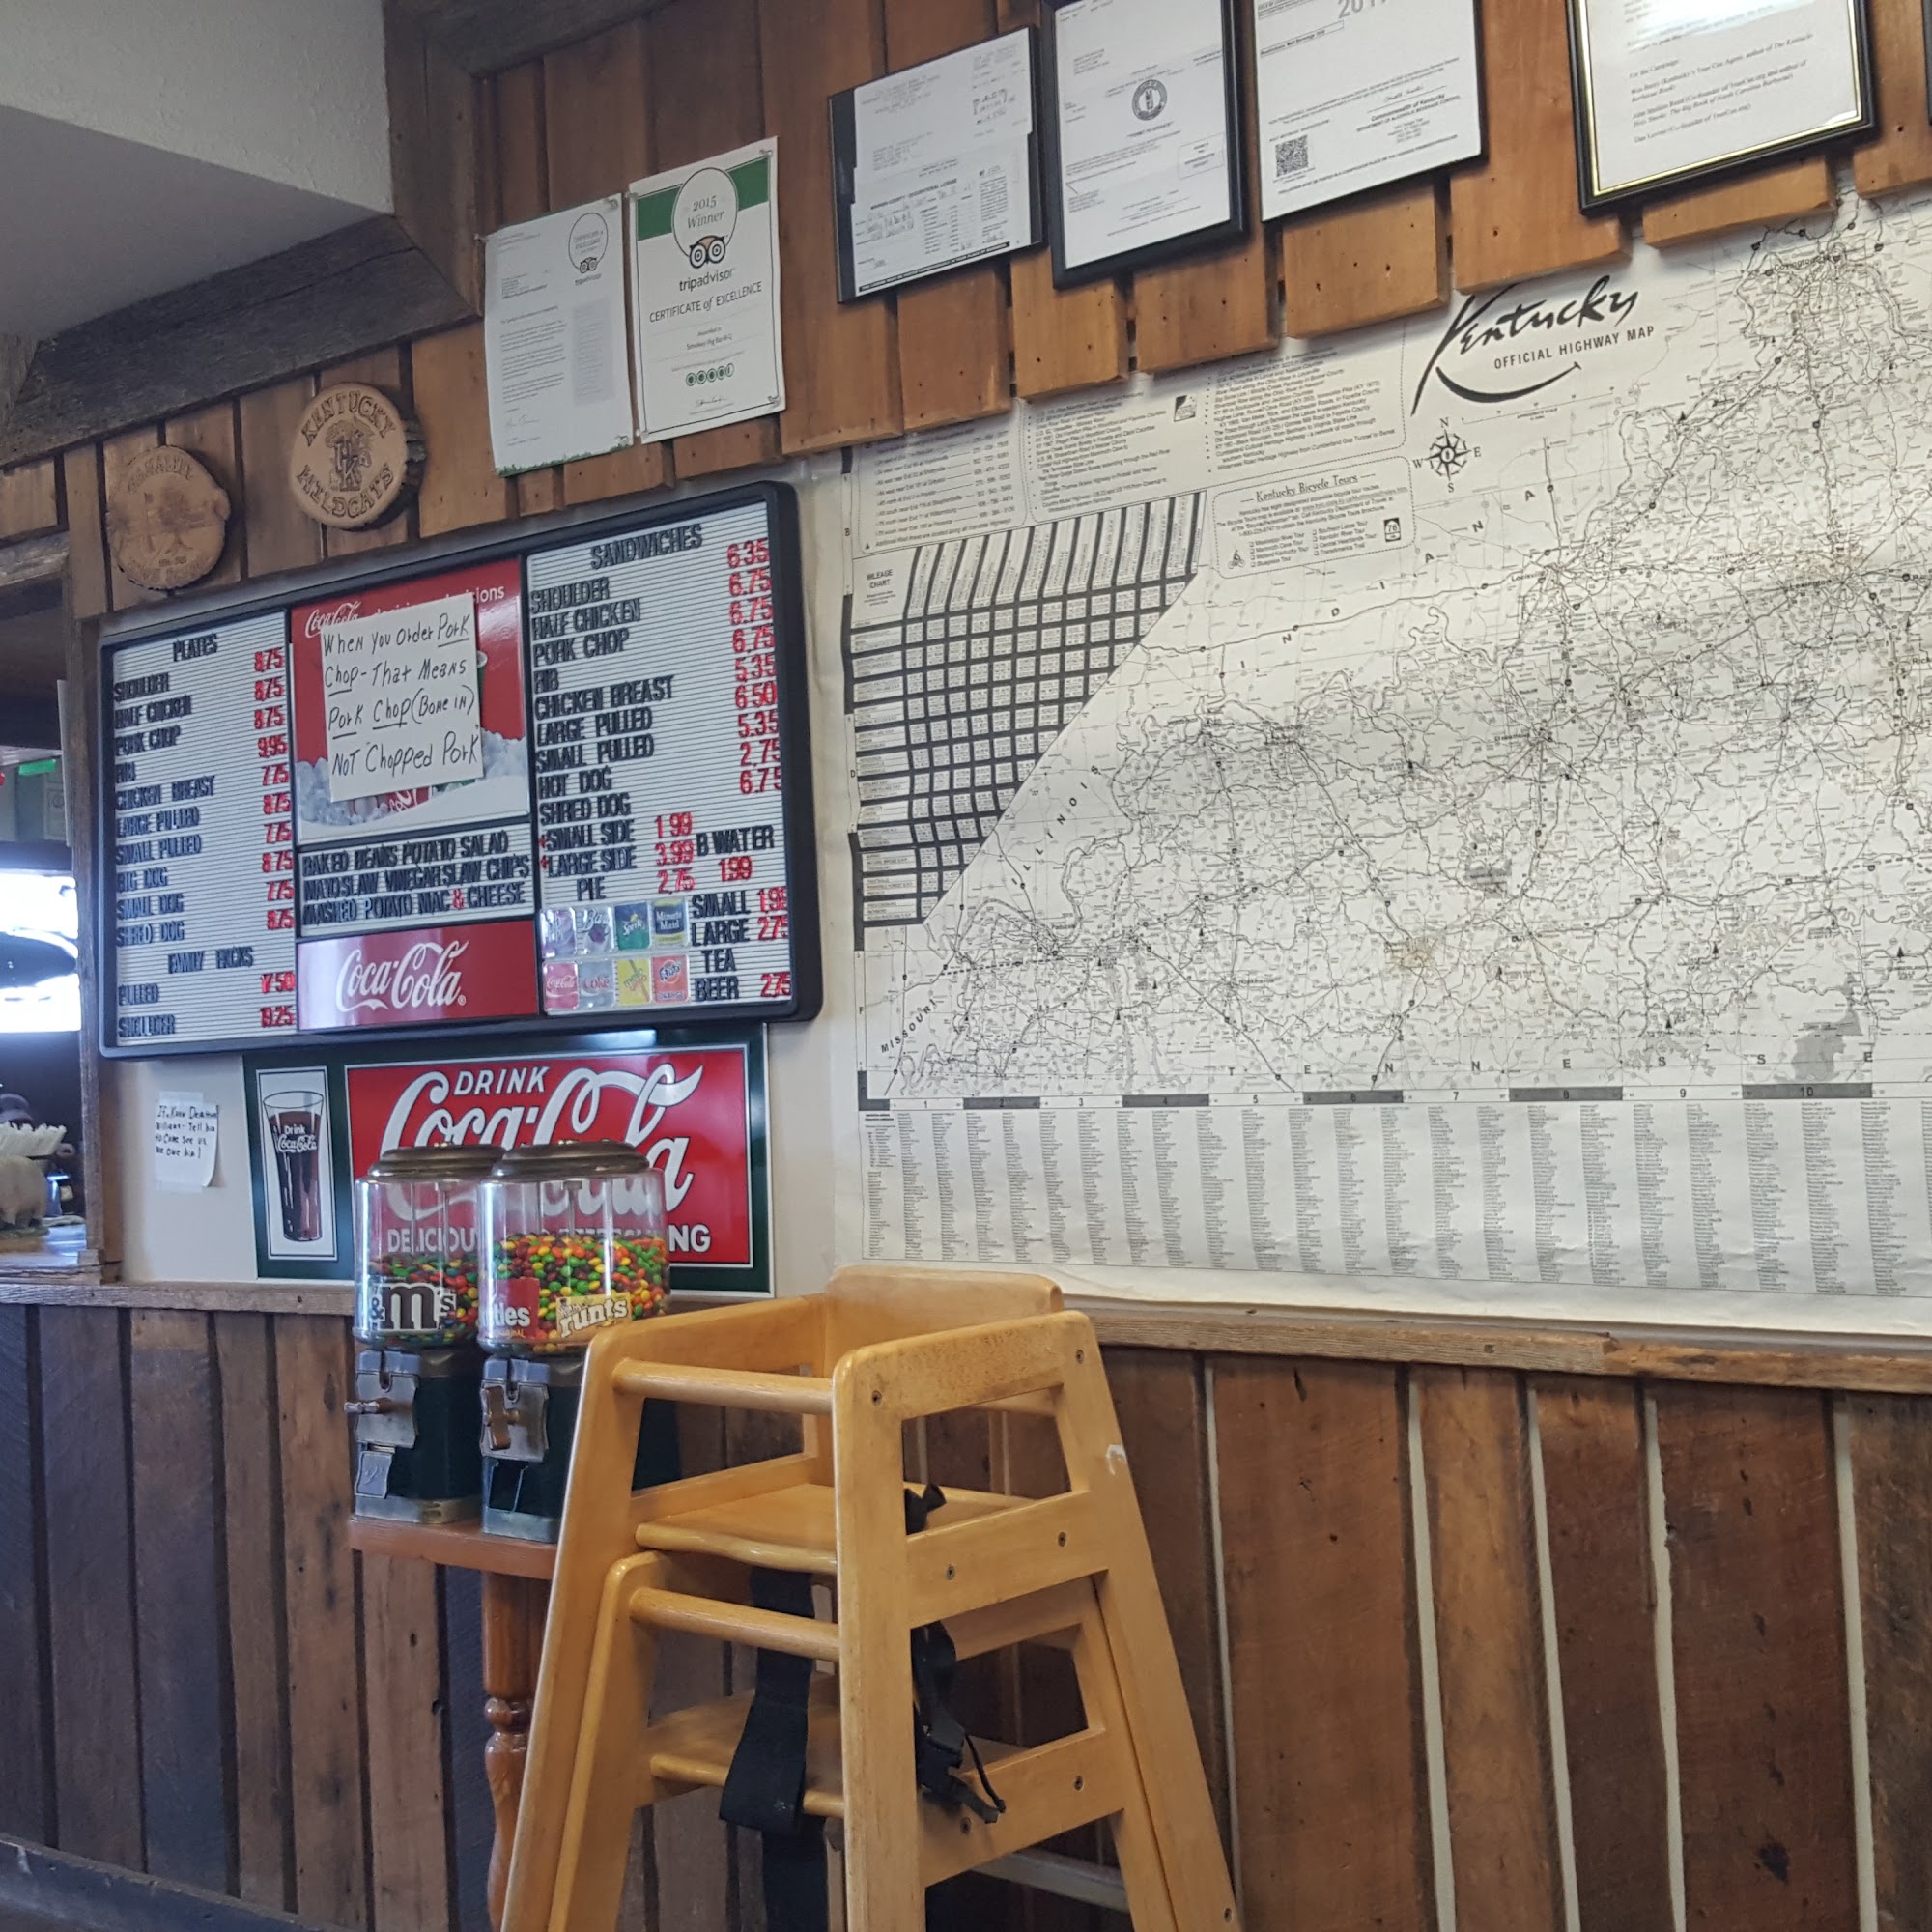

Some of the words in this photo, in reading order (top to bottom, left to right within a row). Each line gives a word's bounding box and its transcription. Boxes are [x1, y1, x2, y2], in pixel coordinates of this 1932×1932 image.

[692, 195, 717, 212] 2015
[687, 211, 724, 230] Winner
[679, 268, 734, 292] tripadvisor
[649, 300, 702, 323] CERTIFICATE
[703, 296, 713, 311] of
[716, 281, 763, 306] EXCELLENCE
[1411, 274, 1639, 417] Kentucky
[1494, 348, 1552, 369] OFFICIAL
[1559, 332, 1620, 356] HIGHWAY
[1627, 326, 1655, 341] MAP
[301, 390, 397, 447] KENTUCKY
[1440, 416, 1449, 428] N
[1413, 458, 1425, 469] W
[1473, 446, 1481, 458] E
[297, 463, 395, 519] WILDCATS
[1256, 486, 1295, 503] Kentucky
[1298, 478, 1329, 494] Bicycle
[1332, 474, 1359, 487] Tours
[1447, 482, 1455, 493] S
[590, 523, 703, 570] SANDWICHES
[867, 568, 894, 581] MILEAGE
[530, 576, 610, 614] SHOULDER
[531, 611, 569, 641] HALF
[572, 597, 640, 634] CHICKEN
[533, 637, 576, 668] PORK
[582, 628, 630, 659] CHOP
[372, 659, 412, 687] That
[533, 668, 560, 695] RIB
[373, 697, 411, 728] Chop
[534, 686, 604, 721] CHICKEN
[610, 674, 675, 710] BREAST
[536, 717, 586, 747] LARGE
[595, 706, 654, 738] PULLED
[366, 743, 433, 778] Chopped
[535, 744, 587, 773] SMALL
[597, 733, 656, 764] PULLED
[539, 773, 569, 800] HOT
[580, 766, 612, 794] DOG
[538, 797, 592, 825] SHRED
[597, 792, 632, 818] DOG
[546, 824, 598, 851] SMALL
[600, 819, 636, 845] SIDE
[696, 832, 709, 857] B
[712, 824, 775, 854] WATER
[302, 850, 349, 877] BAKED
[354, 844, 398, 870] BEANS
[402, 838, 456, 865] POTATO
[460, 830, 509, 859] SALAD
[486, 853, 530, 881] CHIPS
[547, 850, 598, 878] LARGE
[600, 844, 637, 871] SIDE
[302, 898, 357, 926] MASHED
[362, 893, 412, 922] POTATO
[416, 888, 451, 915] MAC
[451, 888, 465, 911] &
[466, 880, 526, 908] CHEESE
[576, 876, 606, 901] PIE
[691, 890, 751, 919] SMALL
[660, 919, 680, 930] Maid
[691, 917, 751, 947] LARGE
[335, 939, 470, 1012] Coca-Cola
[700, 947, 737, 974] TEA
[694, 975, 741, 1003] BEER
[454, 1065, 550, 1096] DRINK
[284, 1123, 306, 1135] Drink
[387, 1226, 477, 1254] DELICIOU
[559, 1297, 630, 1339] runts
